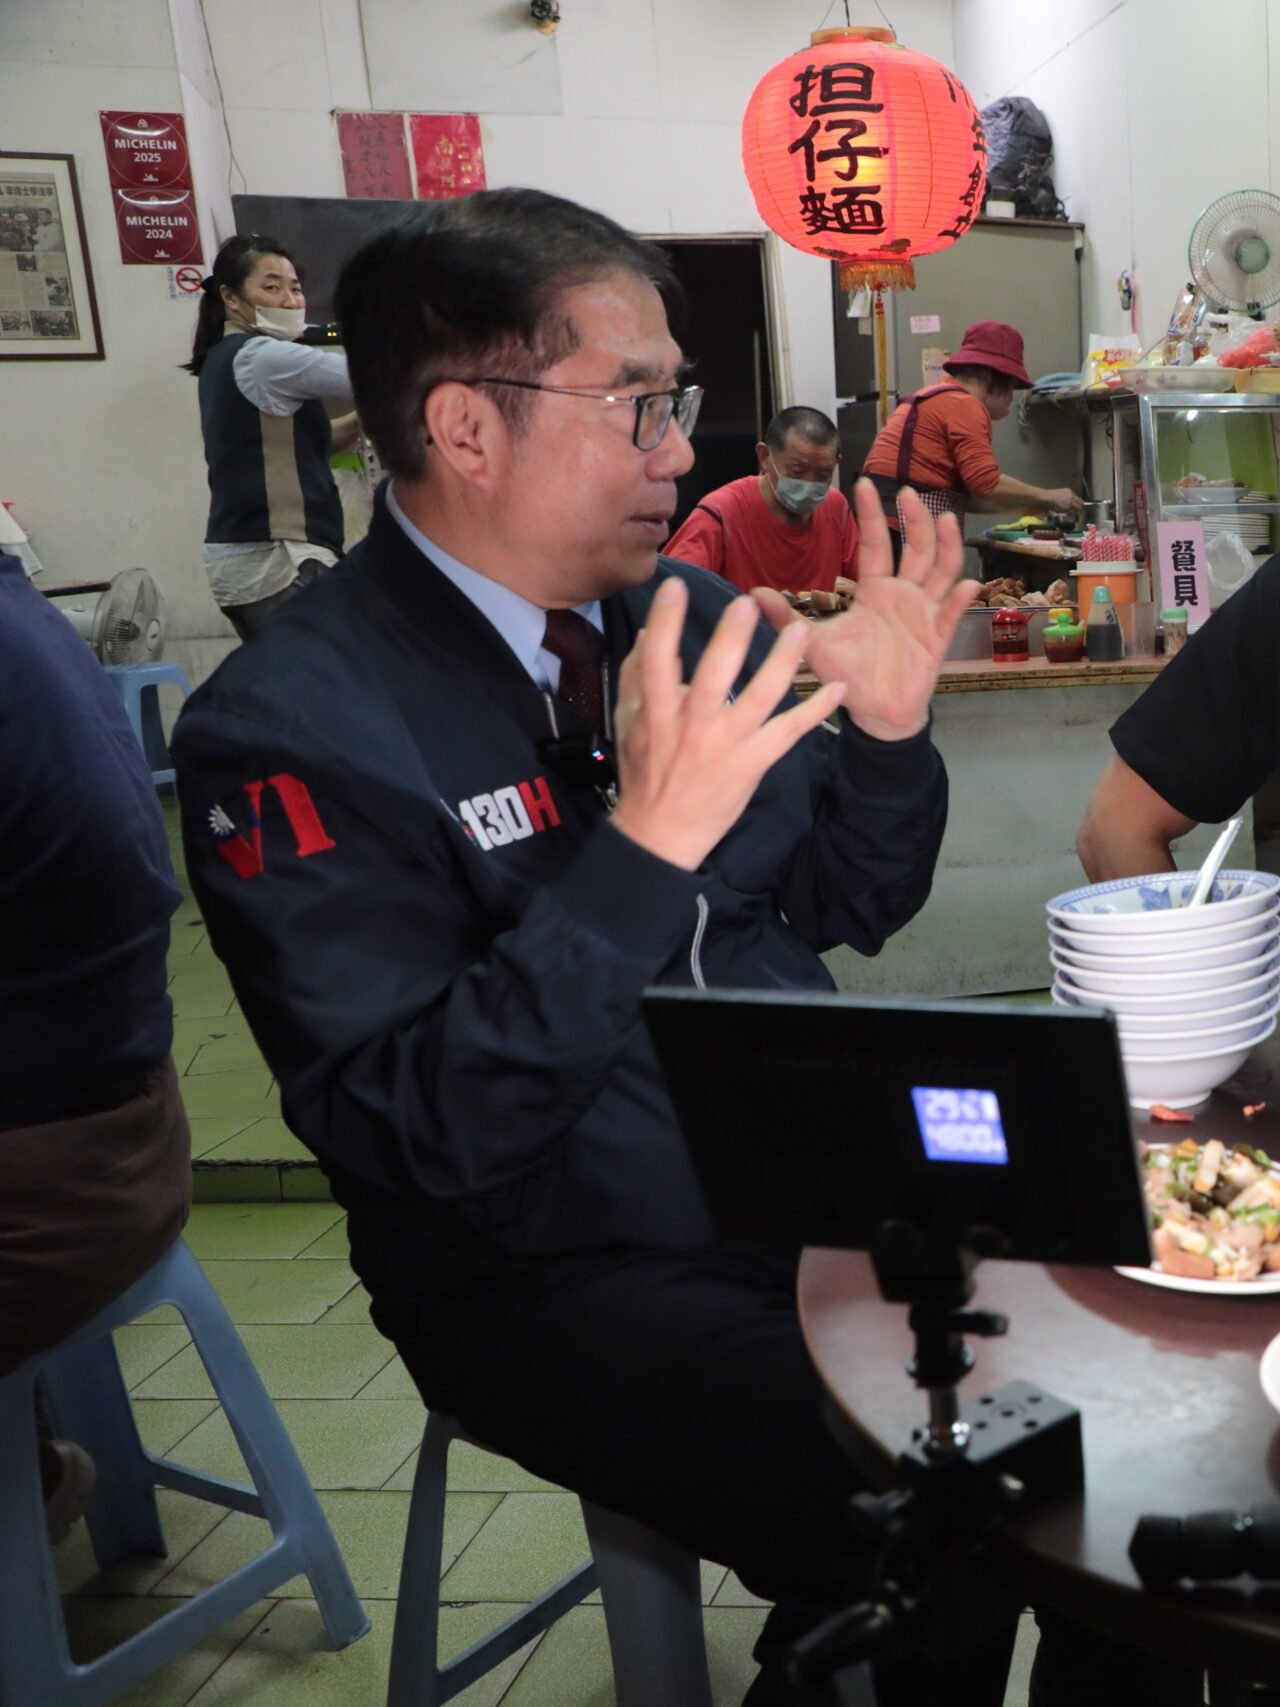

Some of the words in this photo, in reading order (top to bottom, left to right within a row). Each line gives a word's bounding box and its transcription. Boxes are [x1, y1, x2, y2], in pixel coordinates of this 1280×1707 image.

[115, 138, 177, 150] MICHELIN
[788, 62, 890, 236] 担仔麵
[134, 152, 162, 163] 2025
[126, 215, 188, 227] MICHELIN
[145, 229, 173, 239] 2024
[1171, 540, 1199, 607] 餐具
